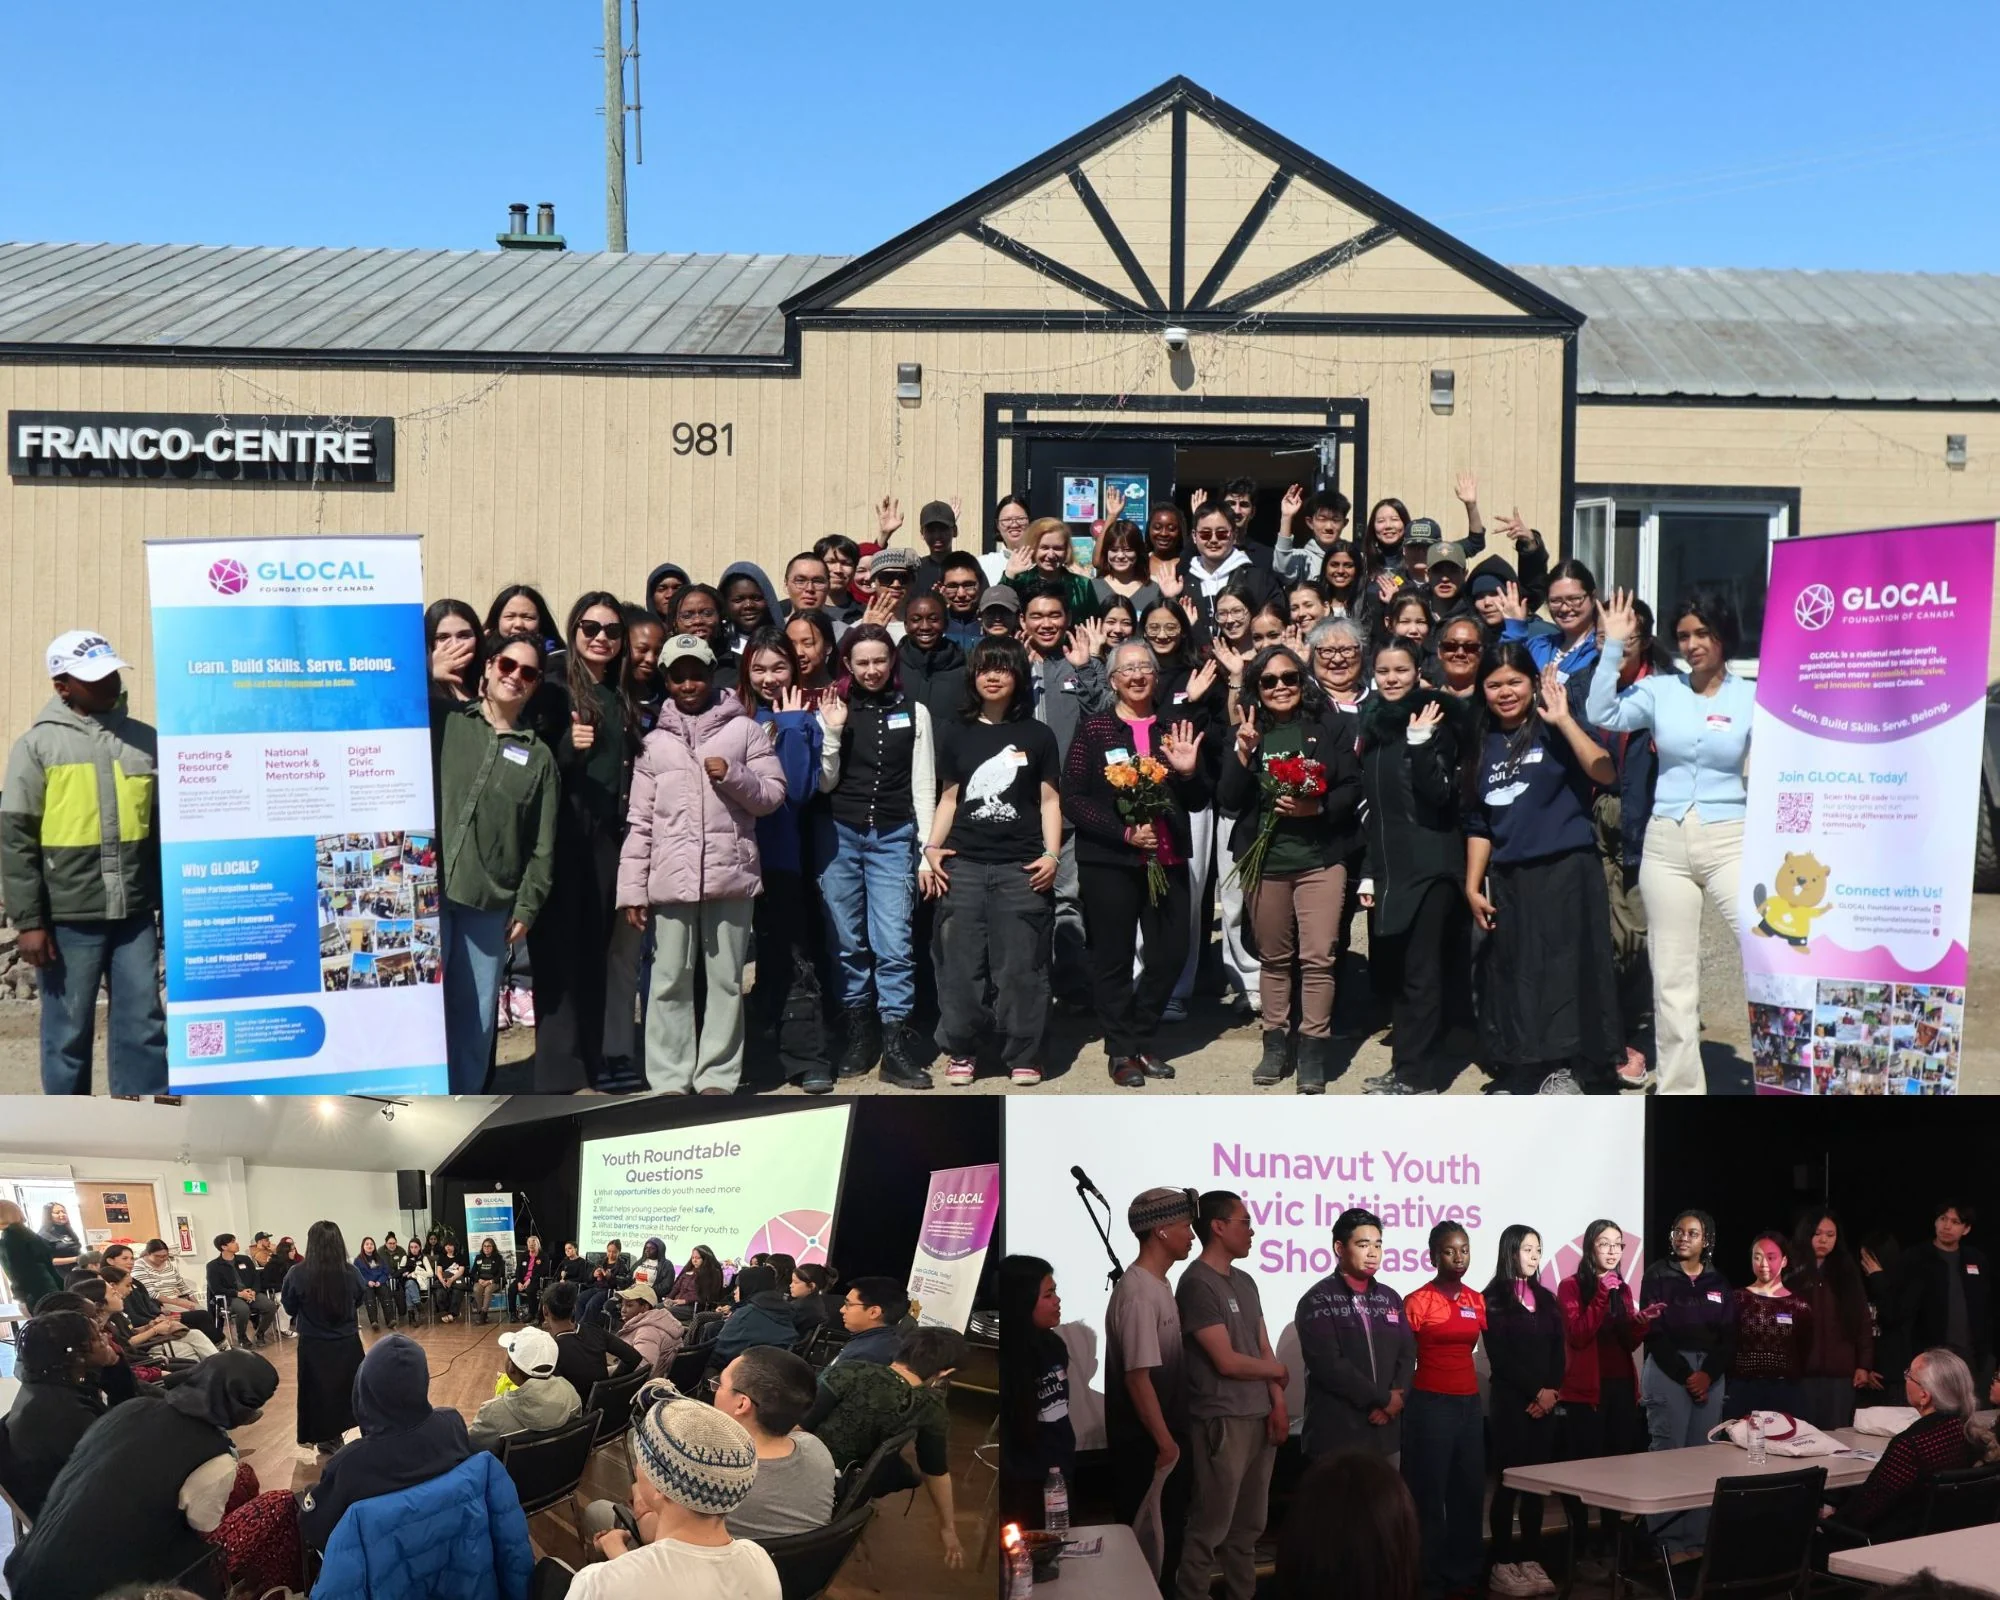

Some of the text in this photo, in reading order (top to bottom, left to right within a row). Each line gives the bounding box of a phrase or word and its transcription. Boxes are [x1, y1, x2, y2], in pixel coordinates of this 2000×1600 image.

[18, 425, 373, 464] FRANCO-CENTRE
[672, 422, 732, 456] 981
[257, 560, 374, 580] GLOCAL
[1842, 580, 1957, 610] GLOCAL
[1842, 610, 1955, 624] FOUNDATION OF CANADA
[1810, 652, 1839, 660] GLOCAL
[1857, 650, 1888, 658] national
[1889, 647, 1936, 656] not-for-profit
[188, 657, 395, 674] Learn. Build Skills. Serve. Belong.
[1800, 661, 1846, 670] organization
[1847, 660, 1889, 668] committed
[1899, 658, 1926, 667] making
[1799, 671, 1846, 682] participation
[1830, 680, 1871, 689] innovative
[1897, 678, 1926, 687] Canada.
[1792, 702, 1951, 732] Learn. Build Skills. Serve. Belong.
[178, 750, 232, 761] Funding &
[265, 748, 308, 757] National
[348, 746, 382, 756] Digital
[266, 759, 320, 768] Network &
[348, 758, 374, 766] Civic
[178, 764, 229, 772] Resource
[349, 768, 395, 778] Platform
[179, 775, 216, 784] Access
[266, 770, 326, 780] Mentorship
[1778, 771, 1908, 786] Join GLOCAL Today!
[1822, 812, 1852, 820] making
[1822, 822, 1866, 830] community
[182, 860, 260, 878] Why GLOCAL?
[1835, 884, 1943, 898] Connect with Us!
[1838, 902, 1865, 910] GLOCAL
[1867, 904, 1900, 912] Foundation
[602, 1141, 741, 1166] Youth Roundtable
[1213, 1142, 1480, 1184] Nunavut Youth
[626, 1166, 704, 1183] Questions
[614, 1188, 660, 1196] opportunities
[662, 1187, 671, 1195] do
[672, 1187, 694, 1196] youth
[696, 1186, 716, 1194] need
[946, 1193, 984, 1204] GLOCAL
[653, 1206, 677, 1214] people
[695, 1205, 715, 1214] safe,
[1241, 1190, 1304, 1226] ivic
[638, 1214, 680, 1222] supported?
[704, 1226, 729, 1234] youth
[730, 1226, 740, 1234] to
[1259, 1239, 1438, 1274] Shoase
